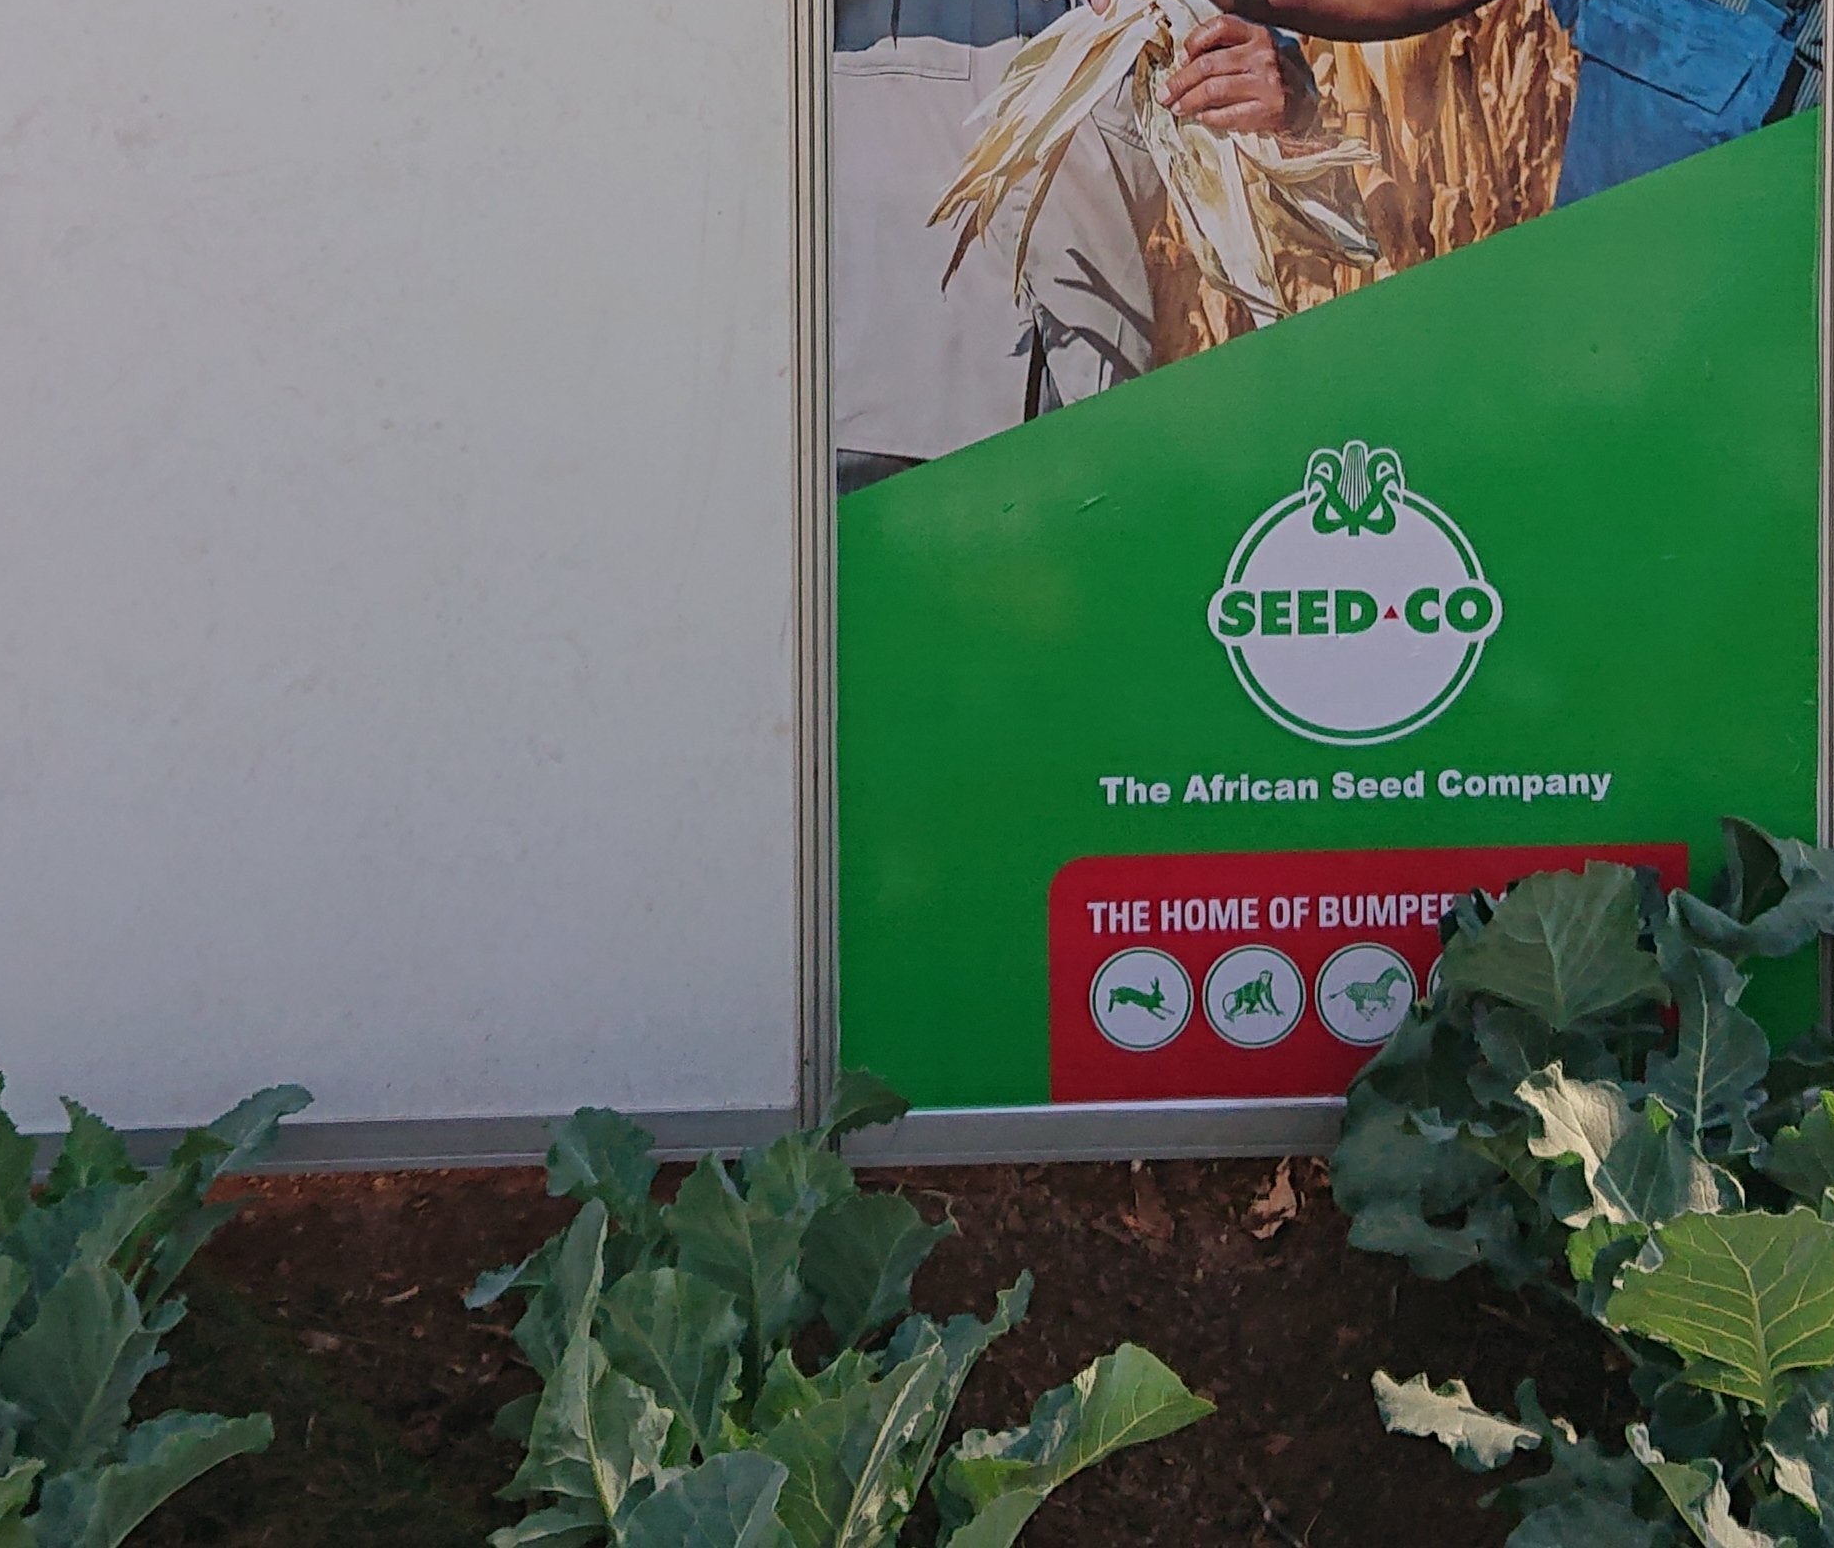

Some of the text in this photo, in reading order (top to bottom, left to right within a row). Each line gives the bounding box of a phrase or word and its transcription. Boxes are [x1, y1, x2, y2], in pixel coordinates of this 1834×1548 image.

[1098, 768, 1613, 805] The African Seed Company
[1086, 899, 1151, 935] THE
[1159, 897, 1260, 933] HOME
[1268, 895, 1310, 930] OF
